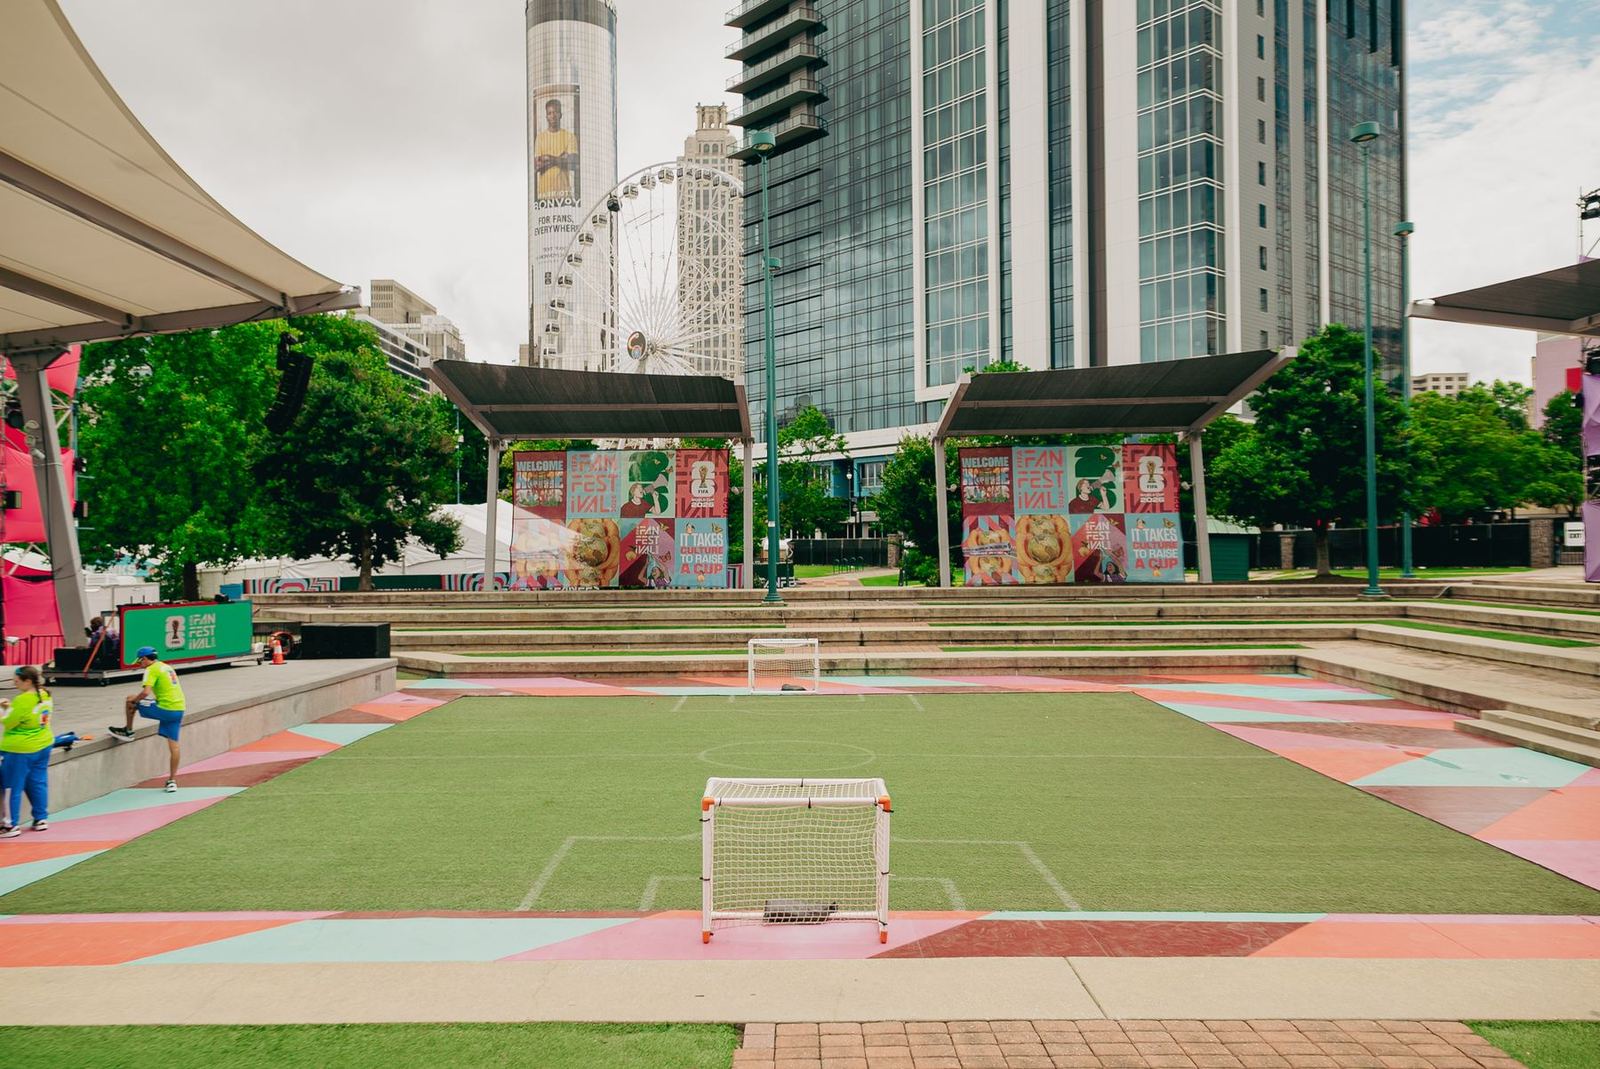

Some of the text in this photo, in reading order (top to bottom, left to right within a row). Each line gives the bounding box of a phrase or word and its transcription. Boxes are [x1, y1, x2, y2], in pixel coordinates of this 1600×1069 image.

[534, 198, 581, 209] BONVOY
[539, 215, 574, 225] FOR FANS,
[578, 453, 616, 471] FAN
[962, 457, 1009, 467] WELCOME
[1024, 449, 1063, 467] FAN
[516, 461, 563, 471] WELCOME
[571, 473, 617, 492] FEST
[1017, 470, 1064, 488] FEST
[640, 525, 659, 535] FAN
[1086, 531, 1110, 540] FEST
[1131, 528, 1178, 541] IT TAKES
[636, 535, 660, 545] FEST
[680, 533, 723, 546] IT TAKES
[1133, 541, 1178, 549] CULTURE
[681, 554, 723, 563] TO RAISE
[1133, 549, 1178, 558] TO RAISE
[681, 563, 723, 574] A CUP
[1135, 558, 1178, 570] A CUP
[192, 613, 216, 625] FAN
[189, 625, 216, 637] FEST
